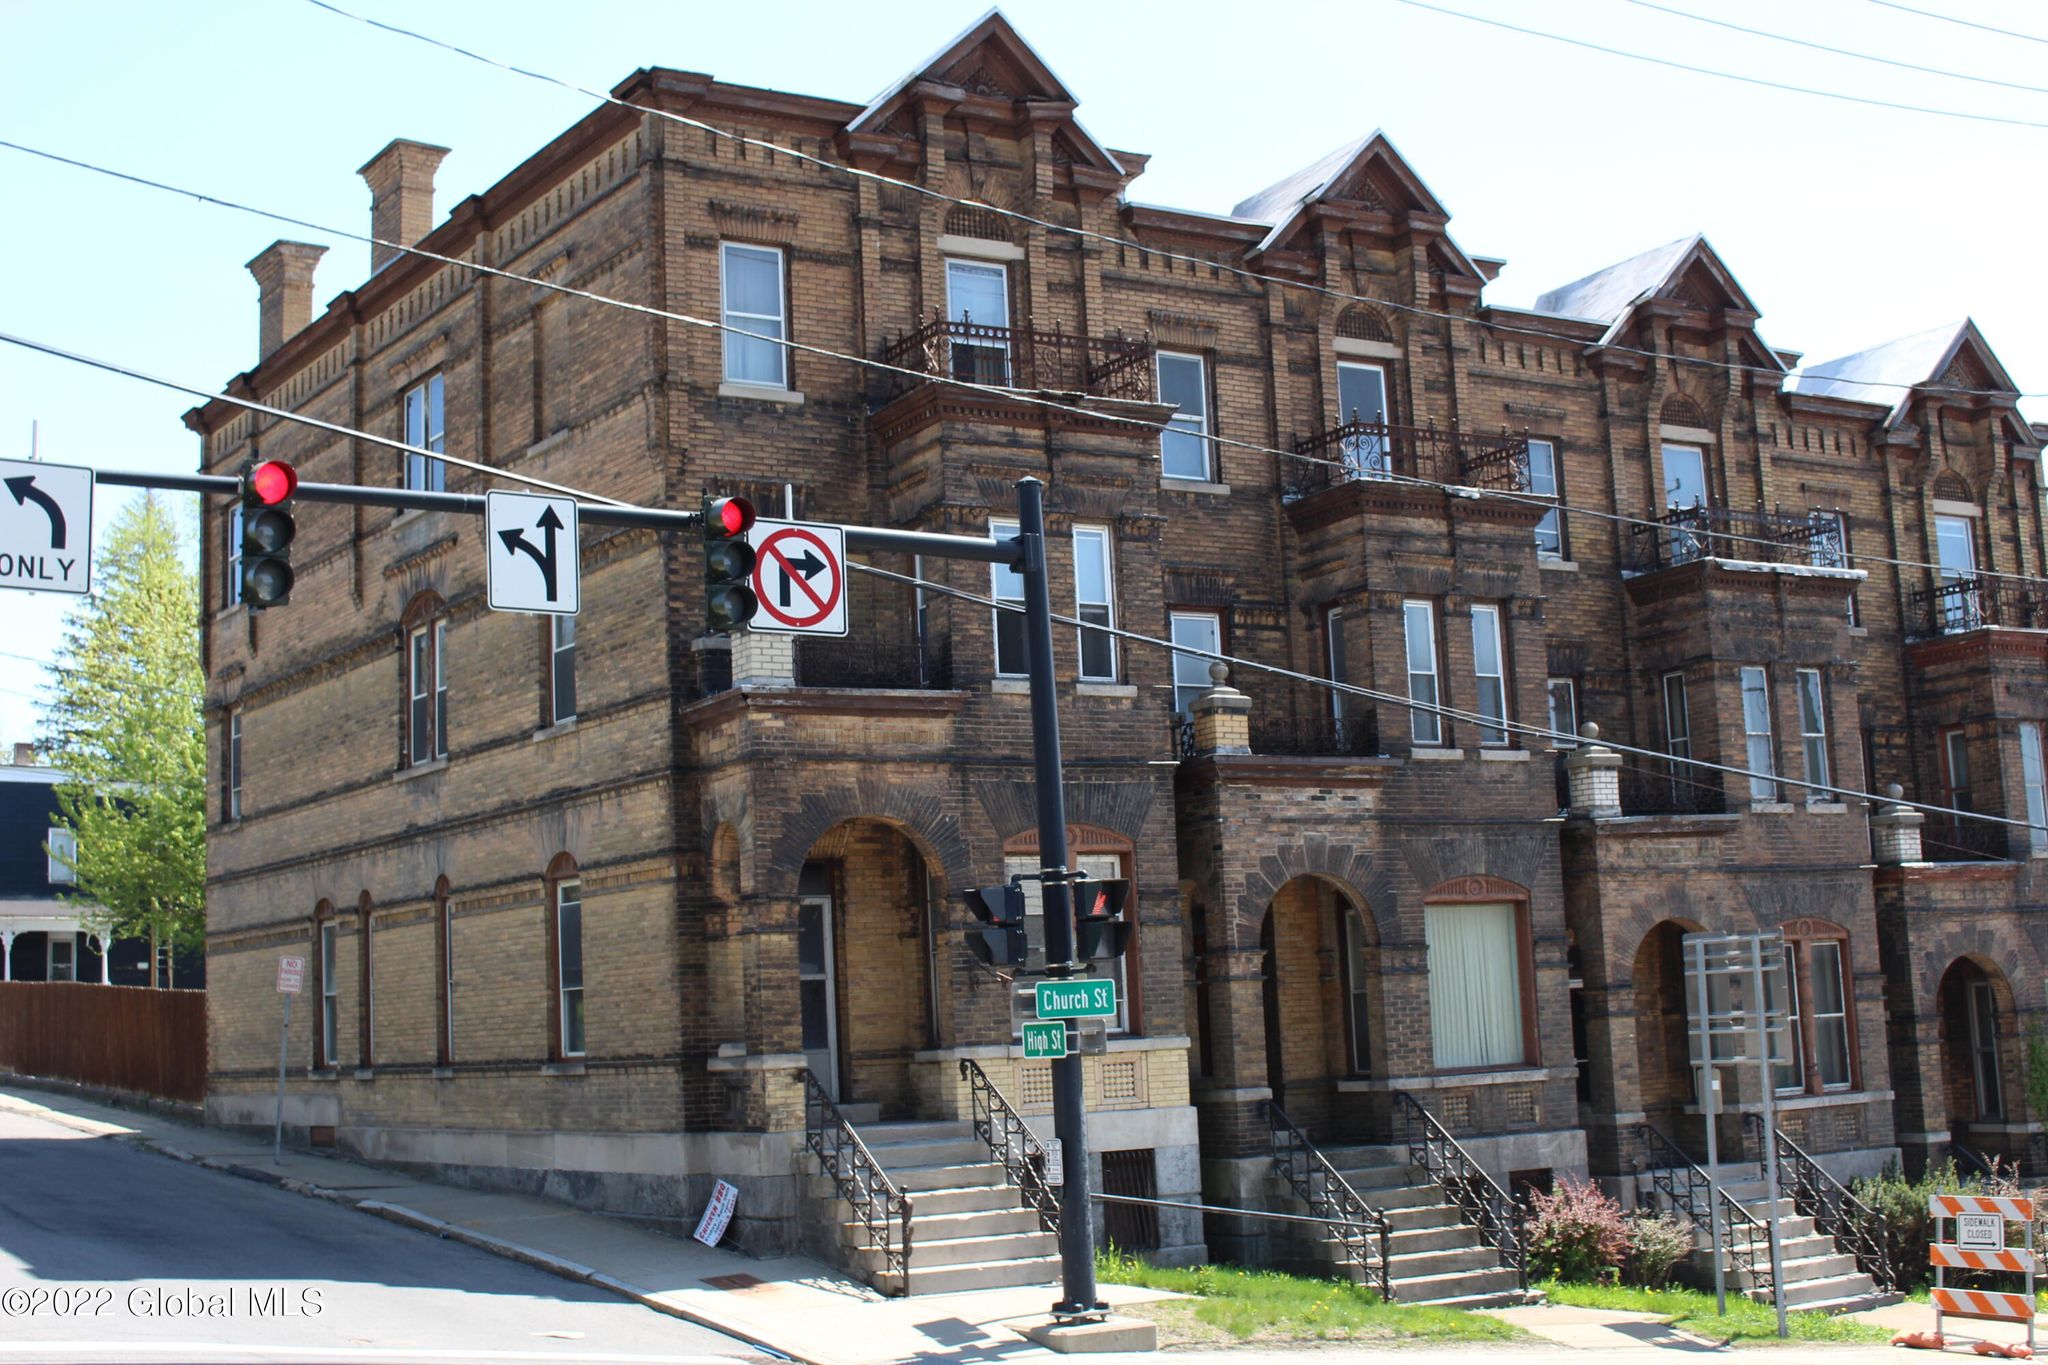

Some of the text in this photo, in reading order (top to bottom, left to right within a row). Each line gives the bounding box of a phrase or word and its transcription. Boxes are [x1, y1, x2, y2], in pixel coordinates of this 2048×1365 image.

[0, 553, 76, 581] ONLY
[286, 960, 298, 969] NO
[1043, 987, 1109, 1010] Church St
[1027, 1029, 1062, 1056] High St
[699, 1205, 718, 1239] CHICKEN
[715, 1183, 726, 1203] BBQ
[1963, 1217, 1995, 1227] SIDEWALK
[1967, 1229, 1993, 1239] CLOSED
